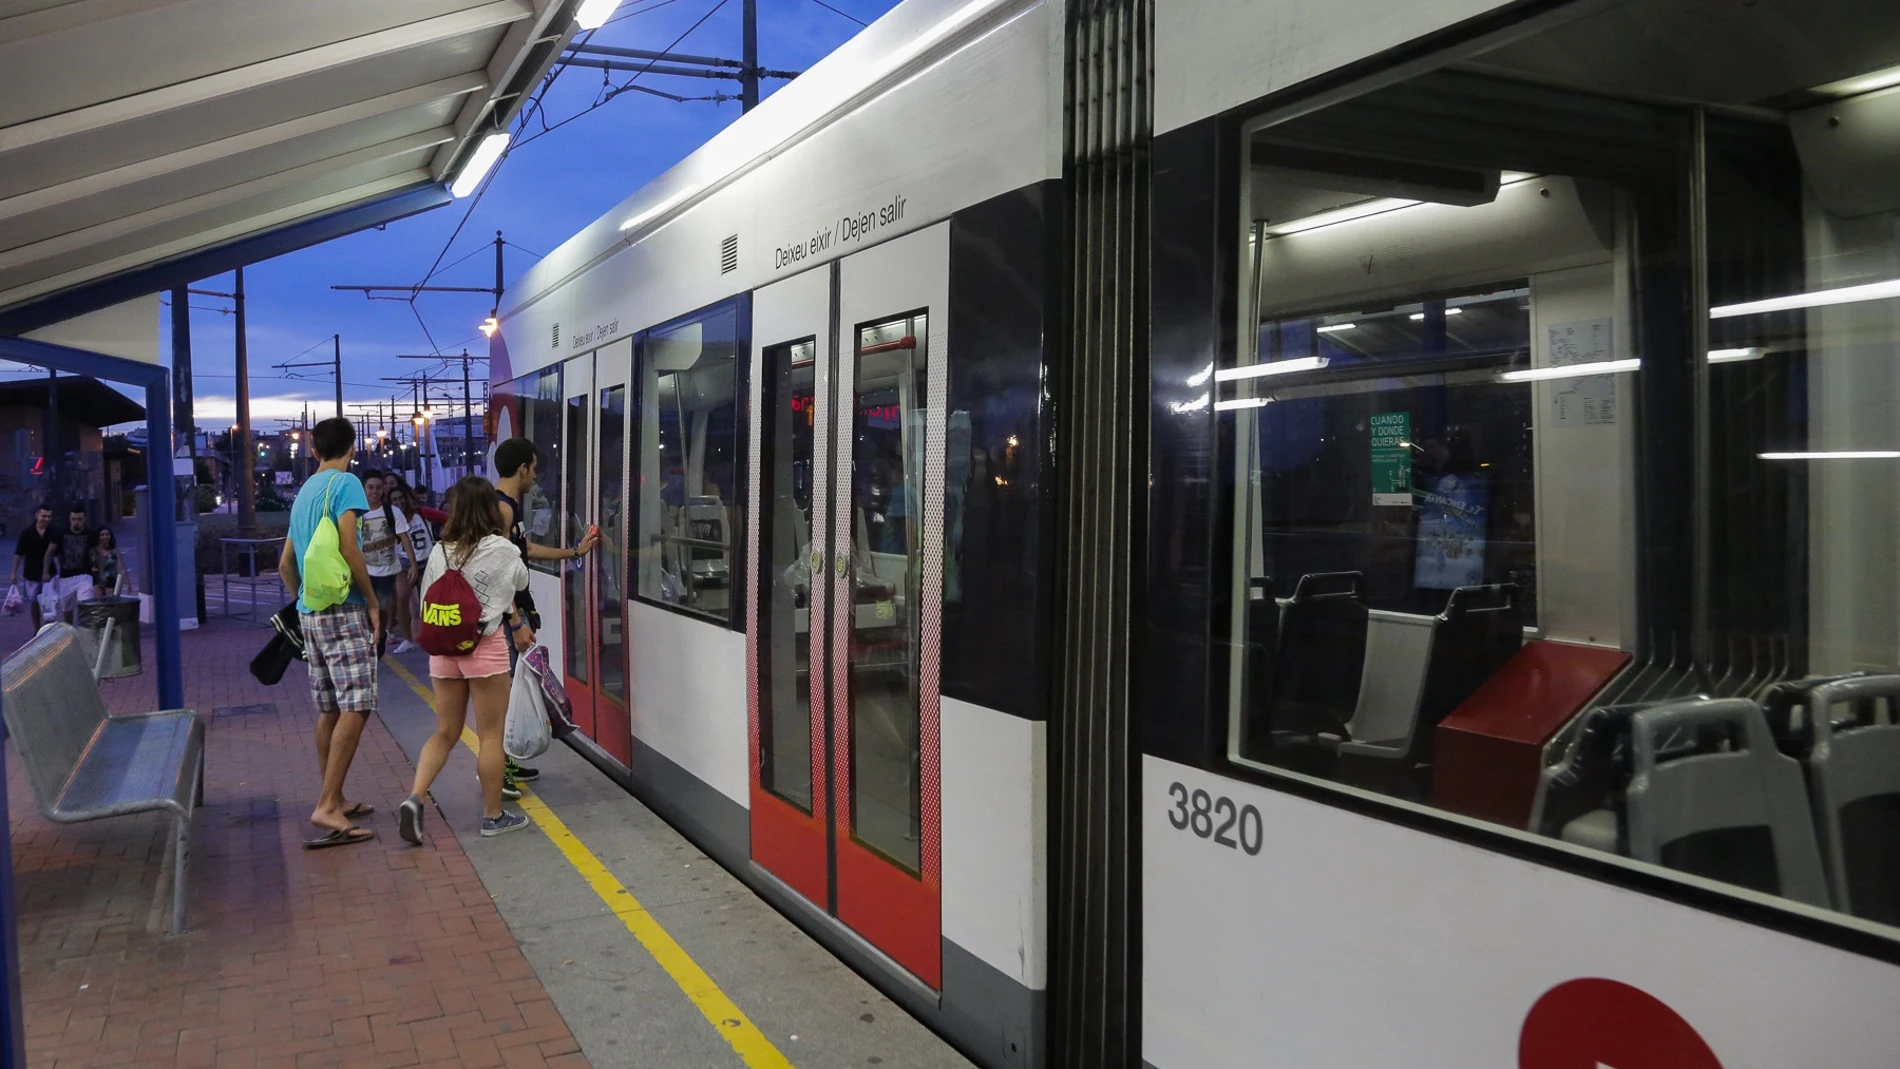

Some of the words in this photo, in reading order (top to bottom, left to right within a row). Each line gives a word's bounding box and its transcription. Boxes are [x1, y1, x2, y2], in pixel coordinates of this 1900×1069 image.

[775, 243, 807, 270] Deixeu
[810, 226, 831, 255] eixir
[834, 220, 840, 246] /
[843, 211, 876, 242] Dejen
[880, 194, 907, 226] salir
[1371, 415, 1404, 425] CUANDO
[1371, 428, 1377, 436] Y
[1378, 426, 1404, 436] DONDE
[423, 601, 461, 626] VANS
[1168, 781, 1263, 856] 3820
